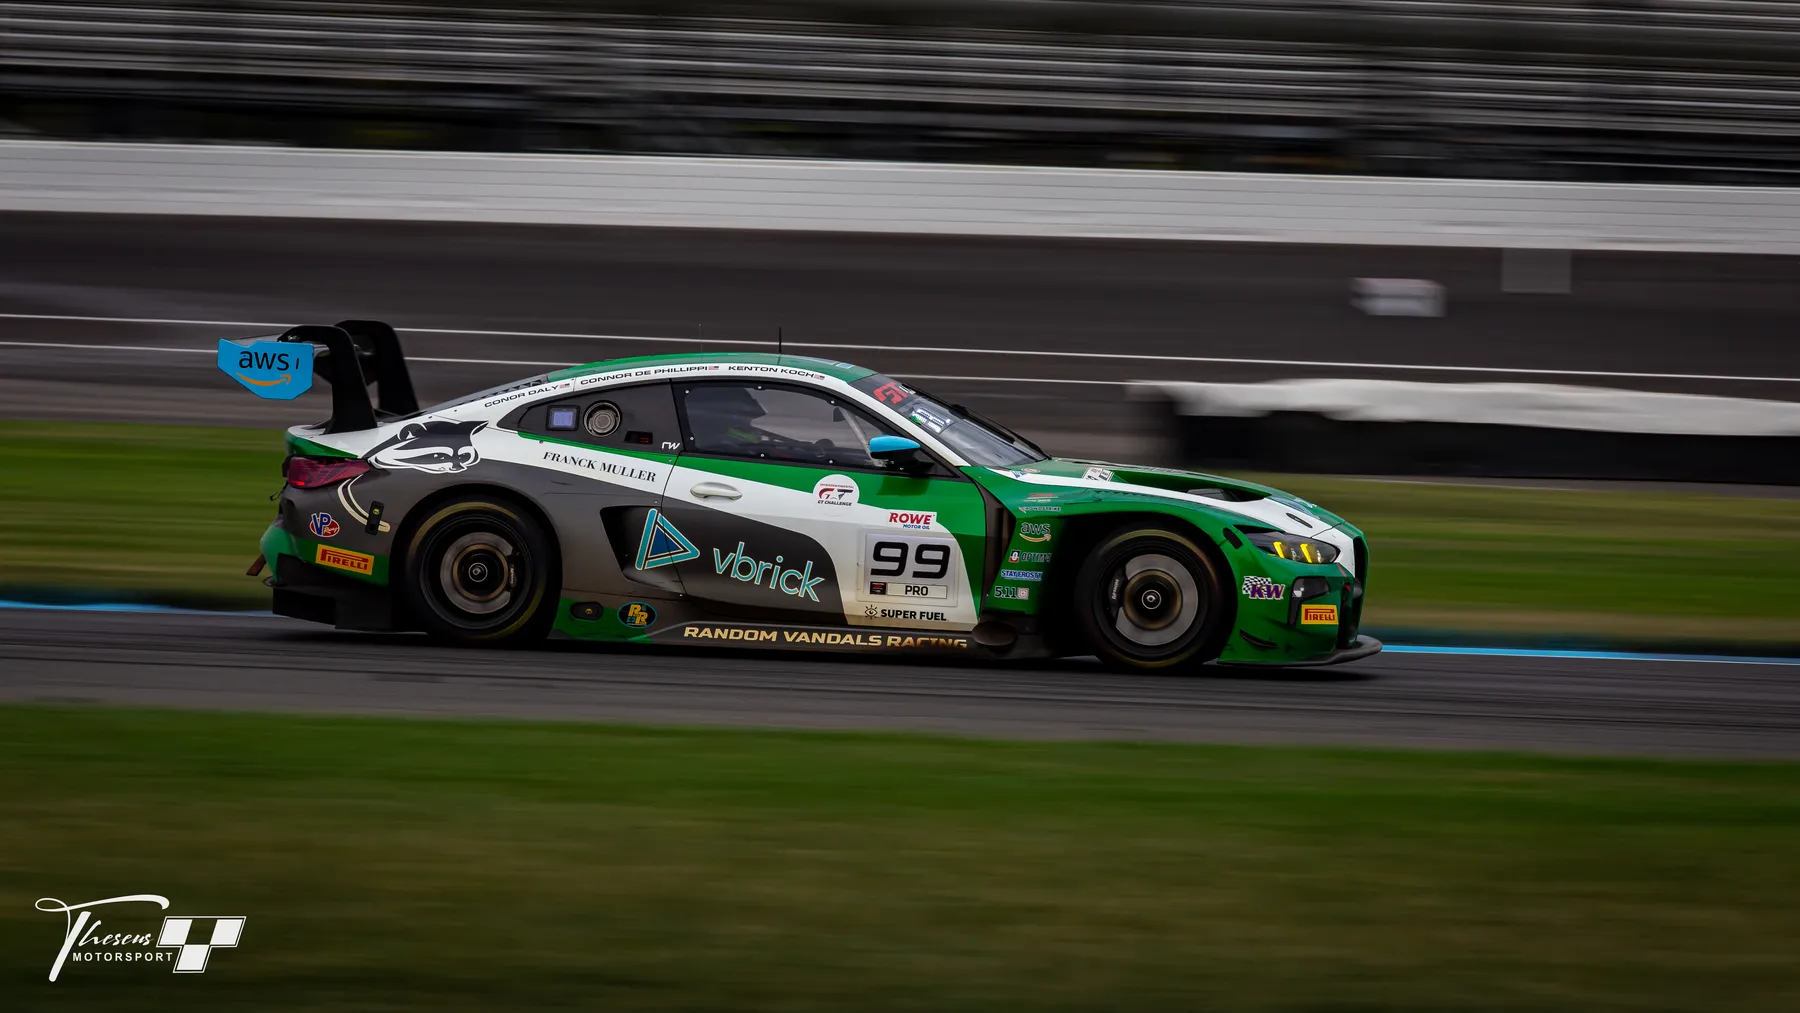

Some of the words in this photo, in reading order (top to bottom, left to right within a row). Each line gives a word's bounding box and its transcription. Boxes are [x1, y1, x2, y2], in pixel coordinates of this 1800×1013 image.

[239, 351, 290, 371] aws
[580, 372, 632, 385] CONNOR
[654, 366, 708, 374] PHILLIPPI
[728, 365, 778, 373] KENTON
[780, 368, 815, 378] KOCH
[484, 392, 525, 408] CONOR
[528, 385, 559, 396] DALY
[543, 451, 597, 470] FRANCK
[600, 462, 657, 482] MULLER
[311, 512, 332, 536] VP
[889, 512, 932, 525] ROWE
[1021, 522, 1051, 535] aws
[320, 548, 369, 571] PIRELLI
[870, 541, 951, 580] 99
[713, 541, 825, 602] vbrick
[1001, 569, 1017, 578] STAY
[904, 585, 929, 596] PRO
[994, 586, 1016, 598] 5.11
[1249, 584, 1285, 600] KW
[881, 609, 917, 620] SUPER
[920, 611, 947, 621] FUEL
[1304, 608, 1336, 621] PIRELLI
[683, 627, 778, 642] RANDOM
[783, 631, 882, 646] VANDALS
[886, 635, 968, 649] RACING
